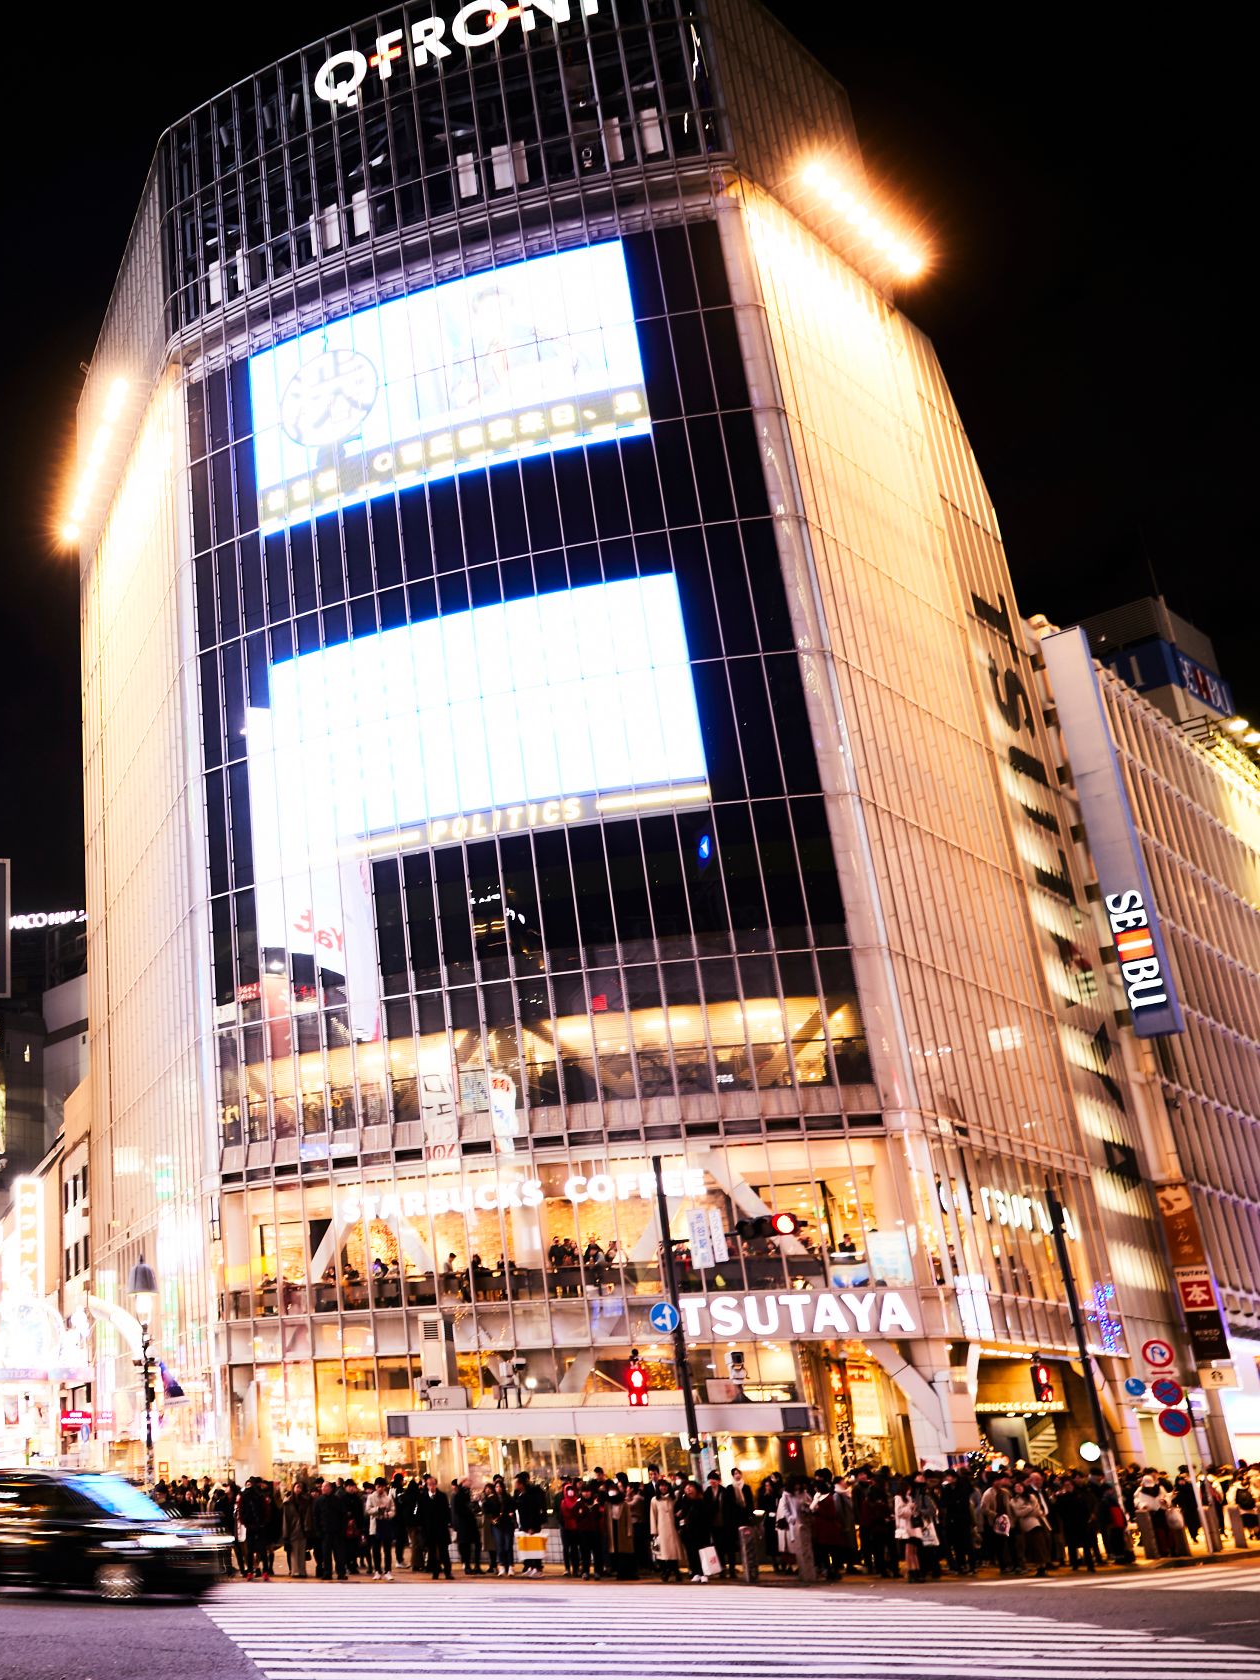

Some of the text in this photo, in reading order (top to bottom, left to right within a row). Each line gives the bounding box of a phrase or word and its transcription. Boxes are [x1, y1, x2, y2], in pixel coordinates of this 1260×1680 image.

[429, 796, 583, 843] POLITICS
[1105, 889, 1168, 1011] SEIBU
[341, 1167, 707, 1224] STARBUCKS COFFEE
[979, 1186, 1078, 1241] TSUTAA
[1176, 1269, 1209, 1277] TSUTAYA
[1185, 1283, 1210, 1304] 本
[679, 1291, 917, 1337] TSUTAYA
[1021, 1400, 1065, 1411] COFFEE
